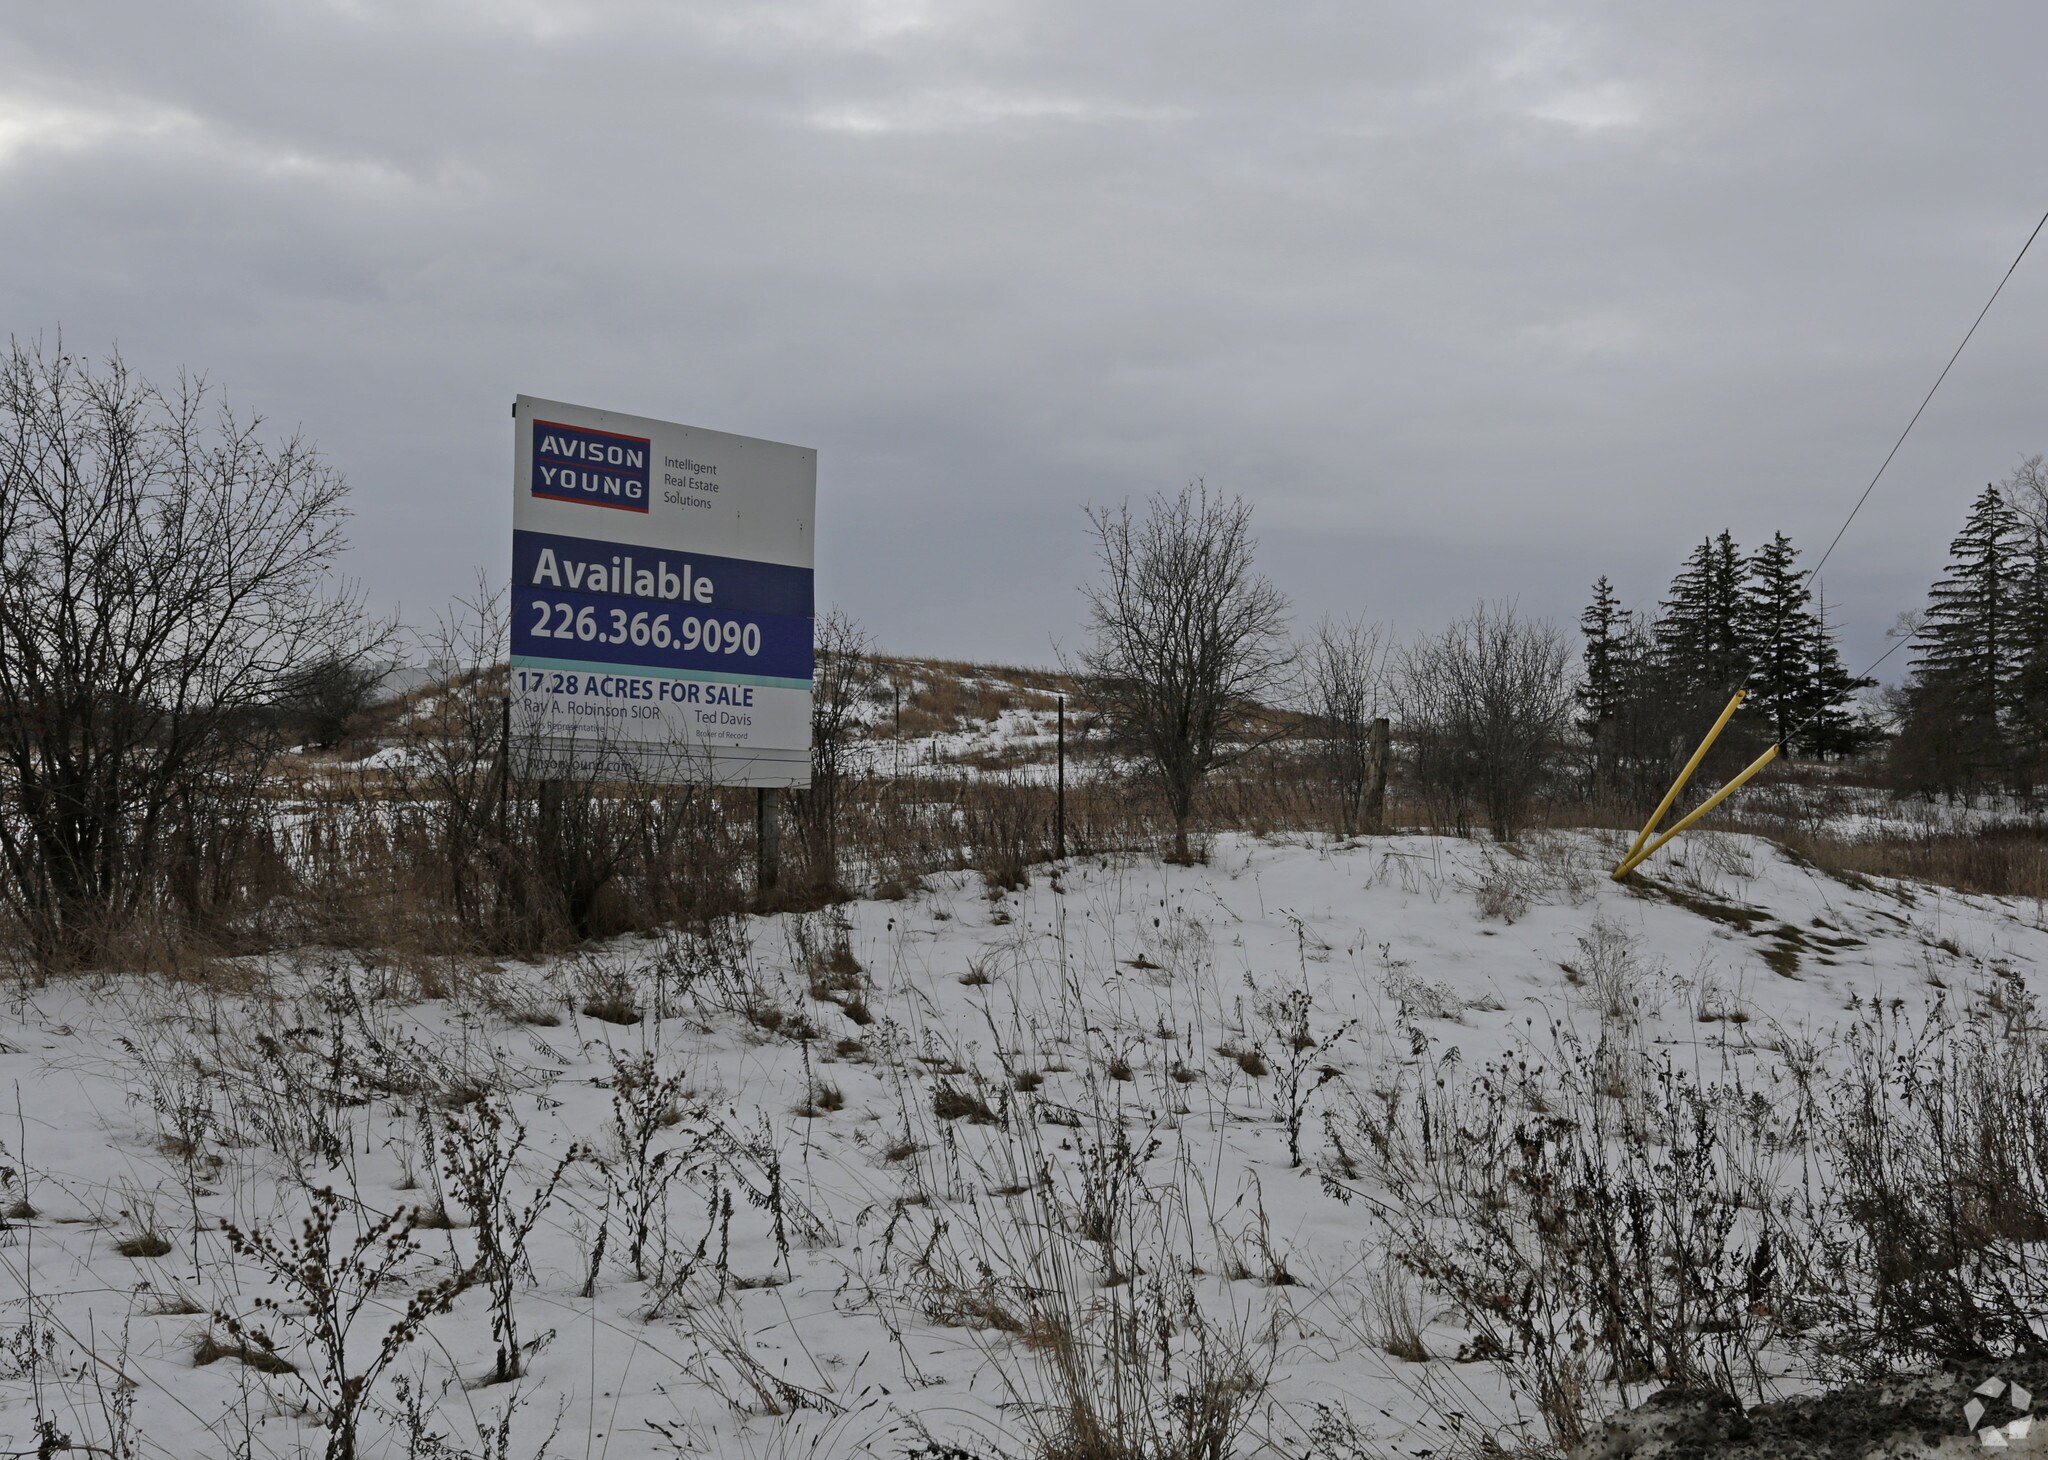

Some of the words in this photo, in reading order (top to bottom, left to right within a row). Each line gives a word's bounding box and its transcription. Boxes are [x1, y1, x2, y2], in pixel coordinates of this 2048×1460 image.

[540, 435, 643, 469] AVISON
[664, 455, 717, 475] Intelligent
[540, 465, 642, 499] YOUNG
[664, 473, 686, 487] Real
[689, 477, 719, 493] Estate
[664, 491, 712, 509] Solutions
[532, 548, 714, 604] Available
[530, 600, 761, 657] 226.366.9090
[518, 671, 579, 695] 17.28
[584, 676, 653, 700] ACRES
[659, 681, 700, 703] FOR
[705, 685, 753, 707] SALE
[524, 698, 548, 716] Ray
[551, 700, 564, 714] A.
[568, 701, 627, 718] Robinson
[631, 705, 660, 719] SIOR
[695, 709, 717, 724] Ted
[720, 711, 752, 726] Davis
[696, 729, 717, 738] Broker
[725, 731, 748, 740] Record
